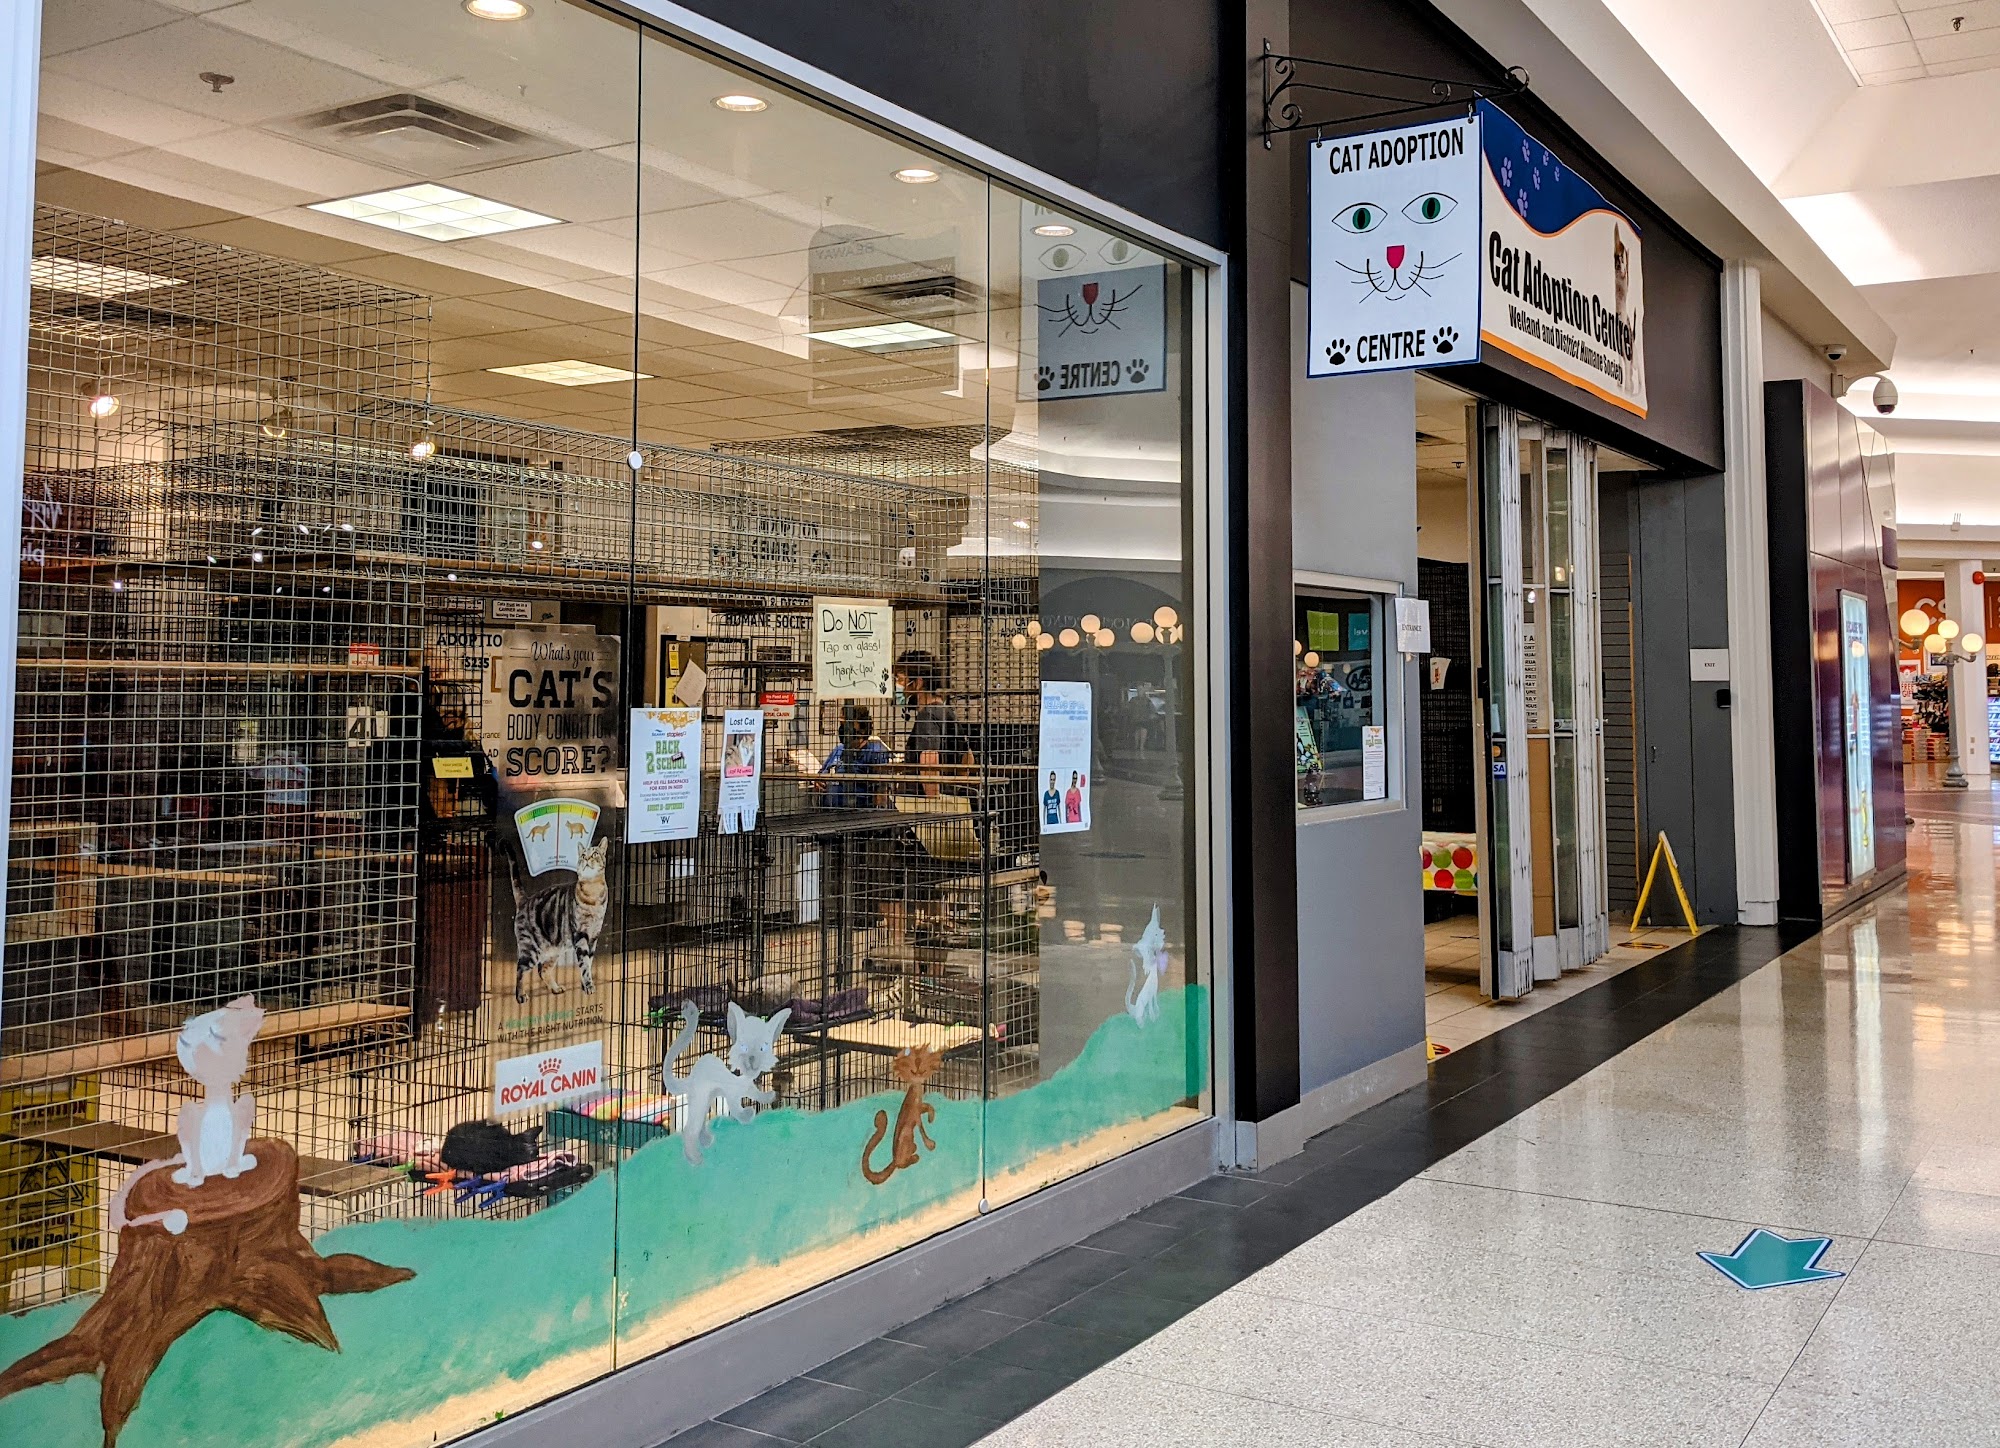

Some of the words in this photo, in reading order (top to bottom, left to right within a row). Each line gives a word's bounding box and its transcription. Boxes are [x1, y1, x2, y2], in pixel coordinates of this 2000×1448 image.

[1329, 143, 1364, 175] CAT
[1367, 126, 1464, 170] ADOPTION
[1489, 230, 1520, 298] Cat
[1522, 250, 1591, 337] Adoption
[1592, 294, 1633, 361] Centre
[1357, 329, 1425, 364] CENTRE
[1508, 303, 1541, 339] Welland
[1541, 323, 1555, 347] and
[1555, 327, 1580, 360] District
[1579, 341, 1603, 372] Humane
[1603, 354, 1623, 384] Society
[776, 614, 814, 630] SOCIET
[823, 609, 843, 632] Do
[848, 609, 878, 631] NOT
[1401, 624, 1422, 632] ENTRANCE
[437, 632, 503, 647] ADOPTIO
[819, 640, 840, 657] Tap
[843, 643, 853, 651] on
[856, 639, 881, 658] glass!
[531, 641, 570, 661] What's
[573, 650, 595, 669] your
[508, 666, 613, 709] CAT'S
[1901, 682, 1914, 690] FREE
[349, 716, 370, 744] 4
[507, 713, 541, 740] BODY
[730, 718, 743, 726] Lost
[744, 717, 755, 726] Cat
[656, 740, 680, 755] BACK
[506, 745, 611, 777] SCORE?
[646, 751, 655, 774] 2
[656, 757, 687, 770] SCHOOL
[1493, 764, 1505, 773] SA
[575, 1003, 604, 1017] STARTS
[497, 1031, 518, 1043] WITH
[520, 1027, 536, 1038] THE
[537, 1023, 561, 1035] RIGHT
[562, 1015, 603, 1031] NUTRITION
[501, 1079, 547, 1105] ROYAL
[550, 1067, 596, 1093] CANIN
